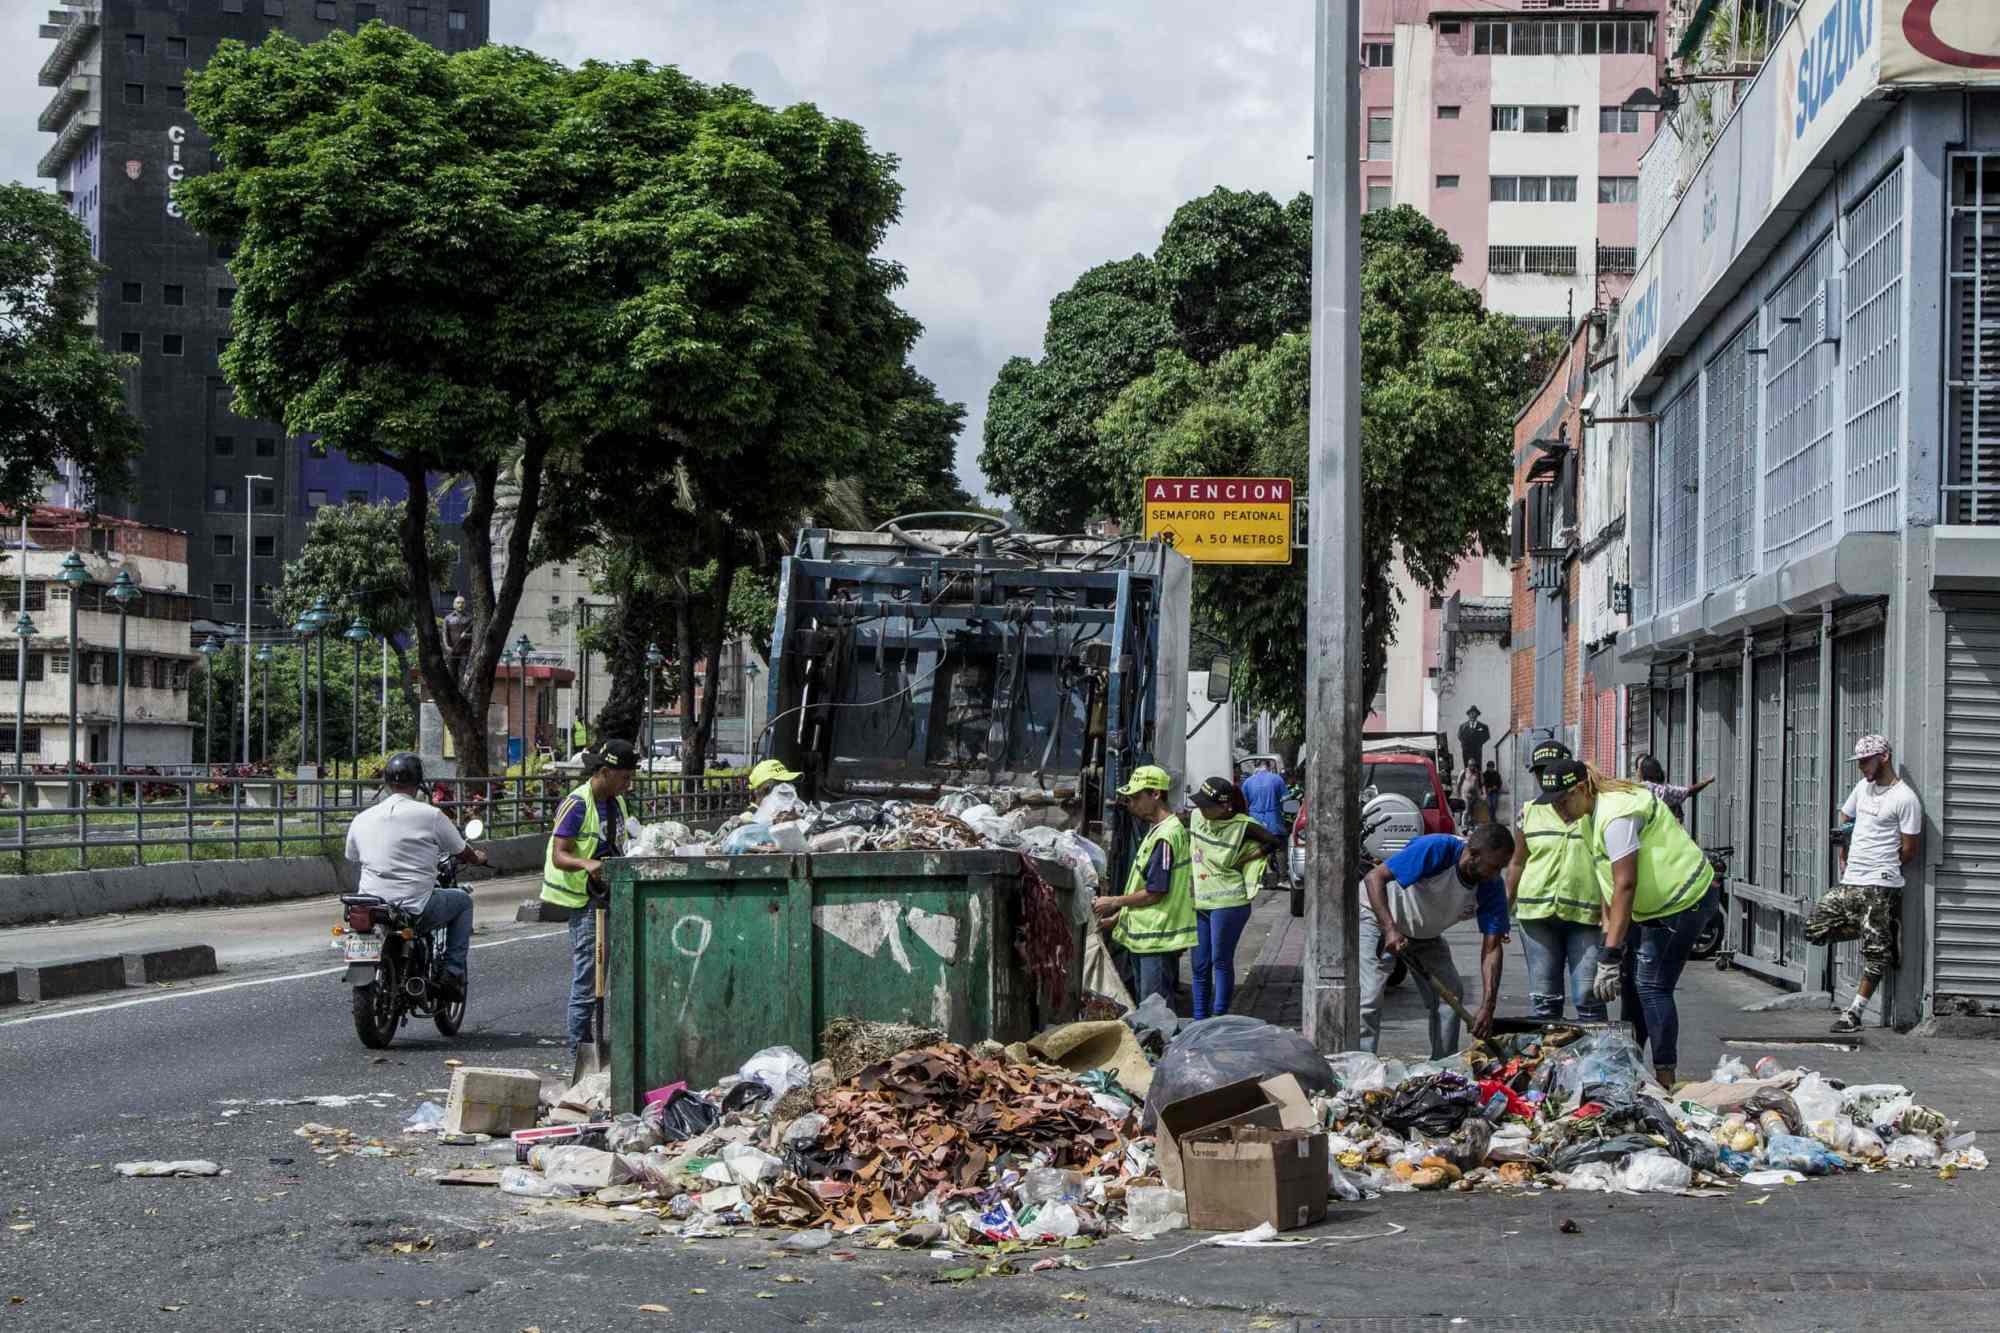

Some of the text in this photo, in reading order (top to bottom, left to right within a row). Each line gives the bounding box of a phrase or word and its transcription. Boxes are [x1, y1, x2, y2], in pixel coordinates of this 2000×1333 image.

[1797, 0, 1873, 140] SUZUKI
[1626, 277, 1660, 369] SUZUKI
[1153, 484, 1283, 499] ATENCION
[1152, 510, 1284, 521] SEMAFORO PEATONAL
[1194, 534, 1284, 545] A 50 METROS
